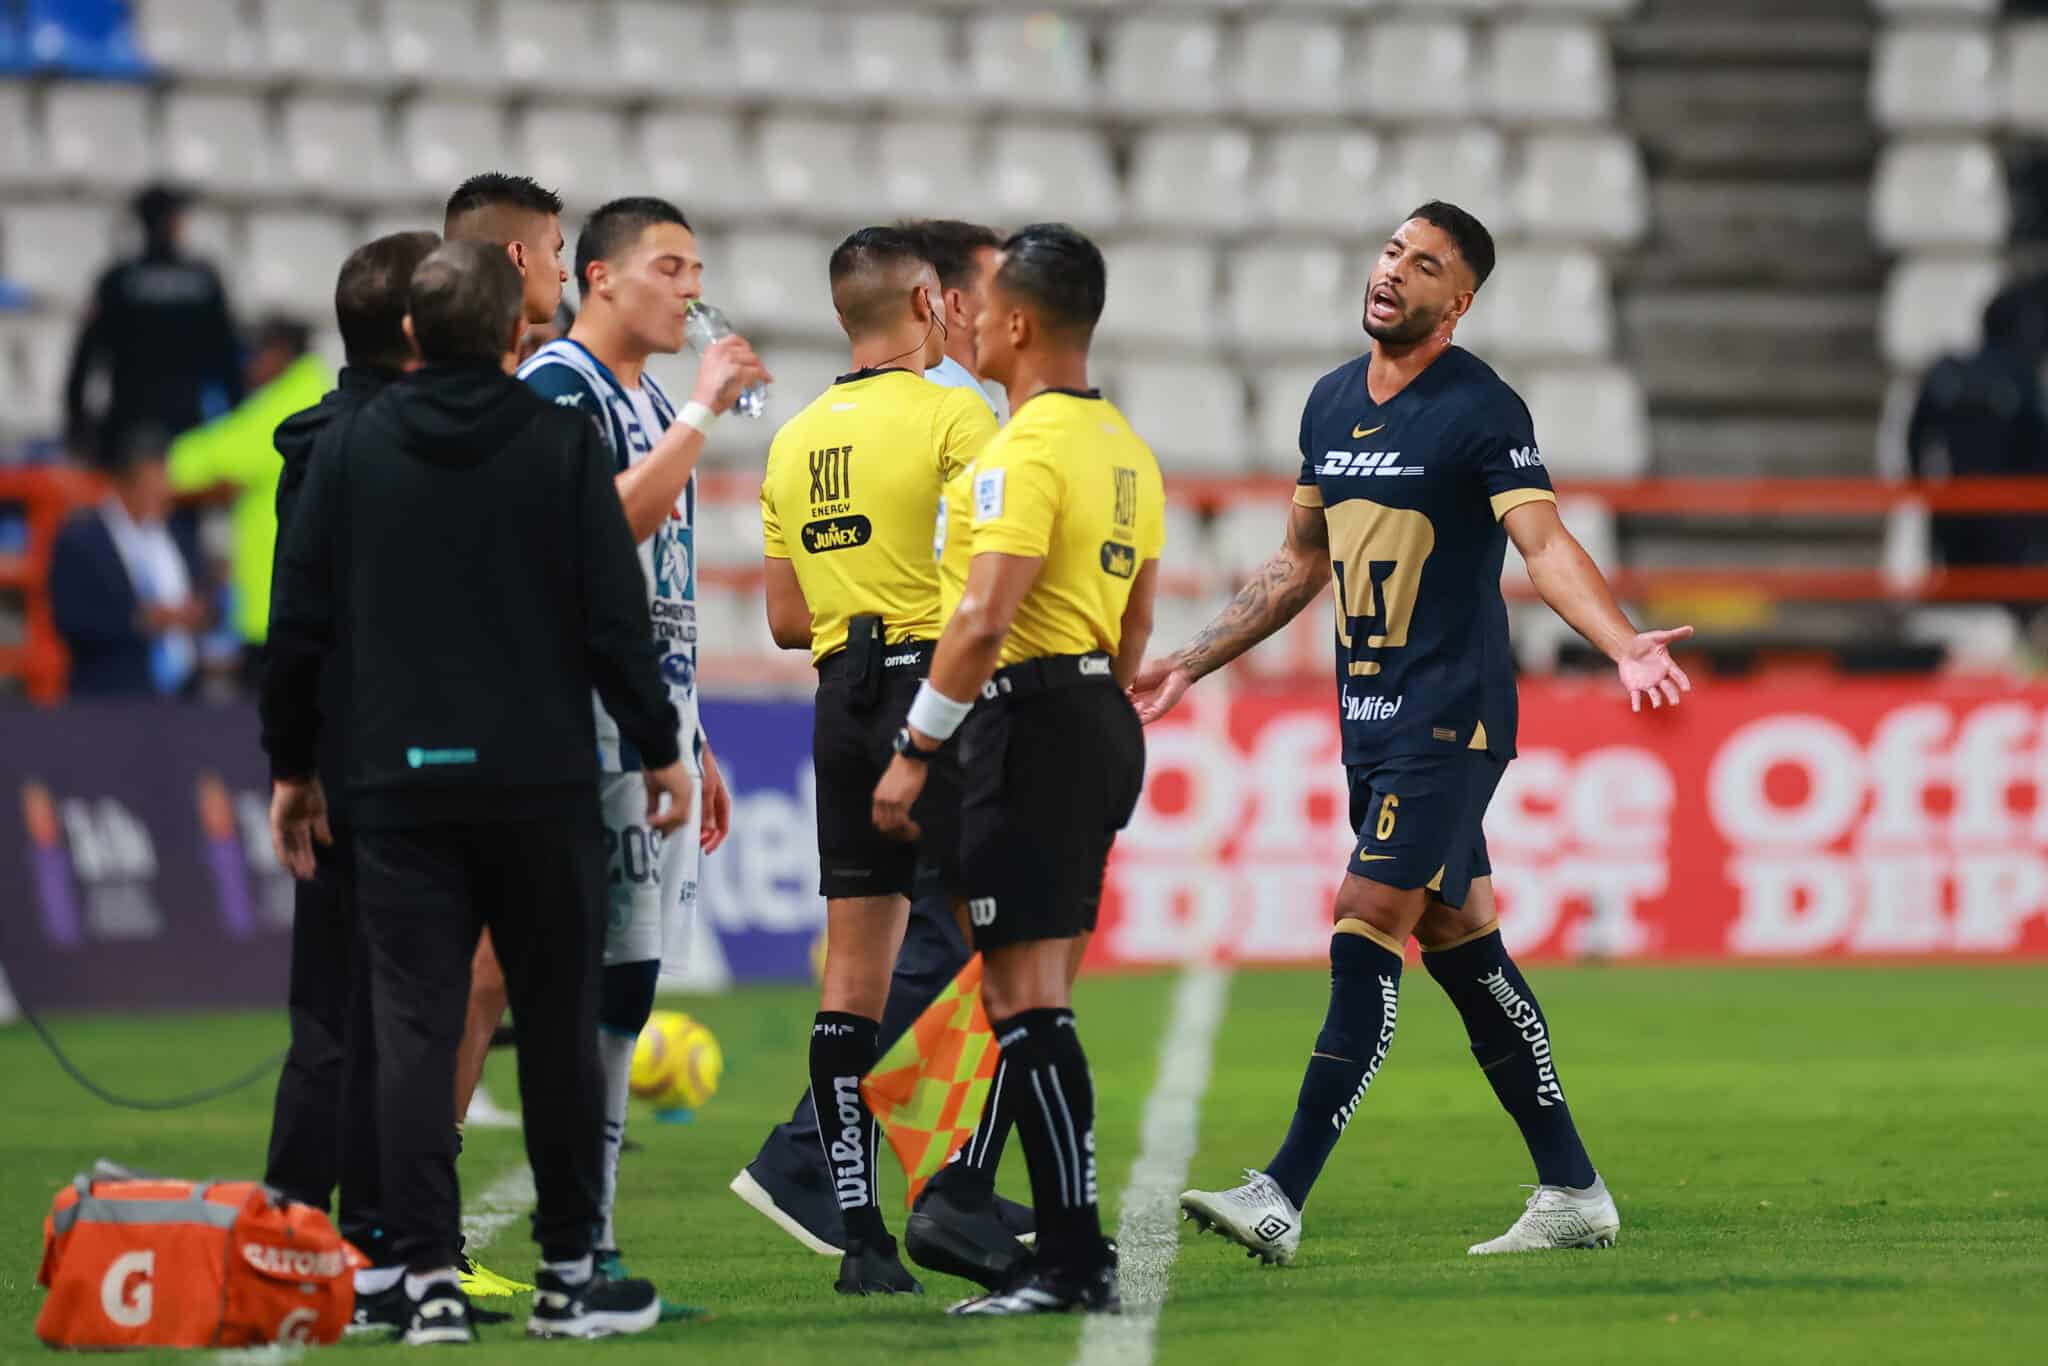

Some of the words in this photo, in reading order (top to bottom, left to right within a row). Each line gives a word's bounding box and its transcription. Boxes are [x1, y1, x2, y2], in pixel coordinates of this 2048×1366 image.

[809, 446, 853, 504] XOT
[1321, 451, 1403, 476] DHL
[811, 503, 850, 517] ENERGY
[814, 527, 859, 549] JUMEX
[885, 652, 921, 667] omex
[1346, 696, 1402, 720] Mifel
[1118, 712, 1675, 852] Ofce
[1706, 702, 2048, 848] Off
[1376, 794, 1399, 841] 6
[1104, 858, 1668, 960] DEOT
[1331, 974, 1399, 1134] BRIDGESTONE
[1477, 967, 1564, 1106] BRIDGESTONE
[831, 1076, 868, 1210] Wilson
[101, 1250, 154, 1326] G
